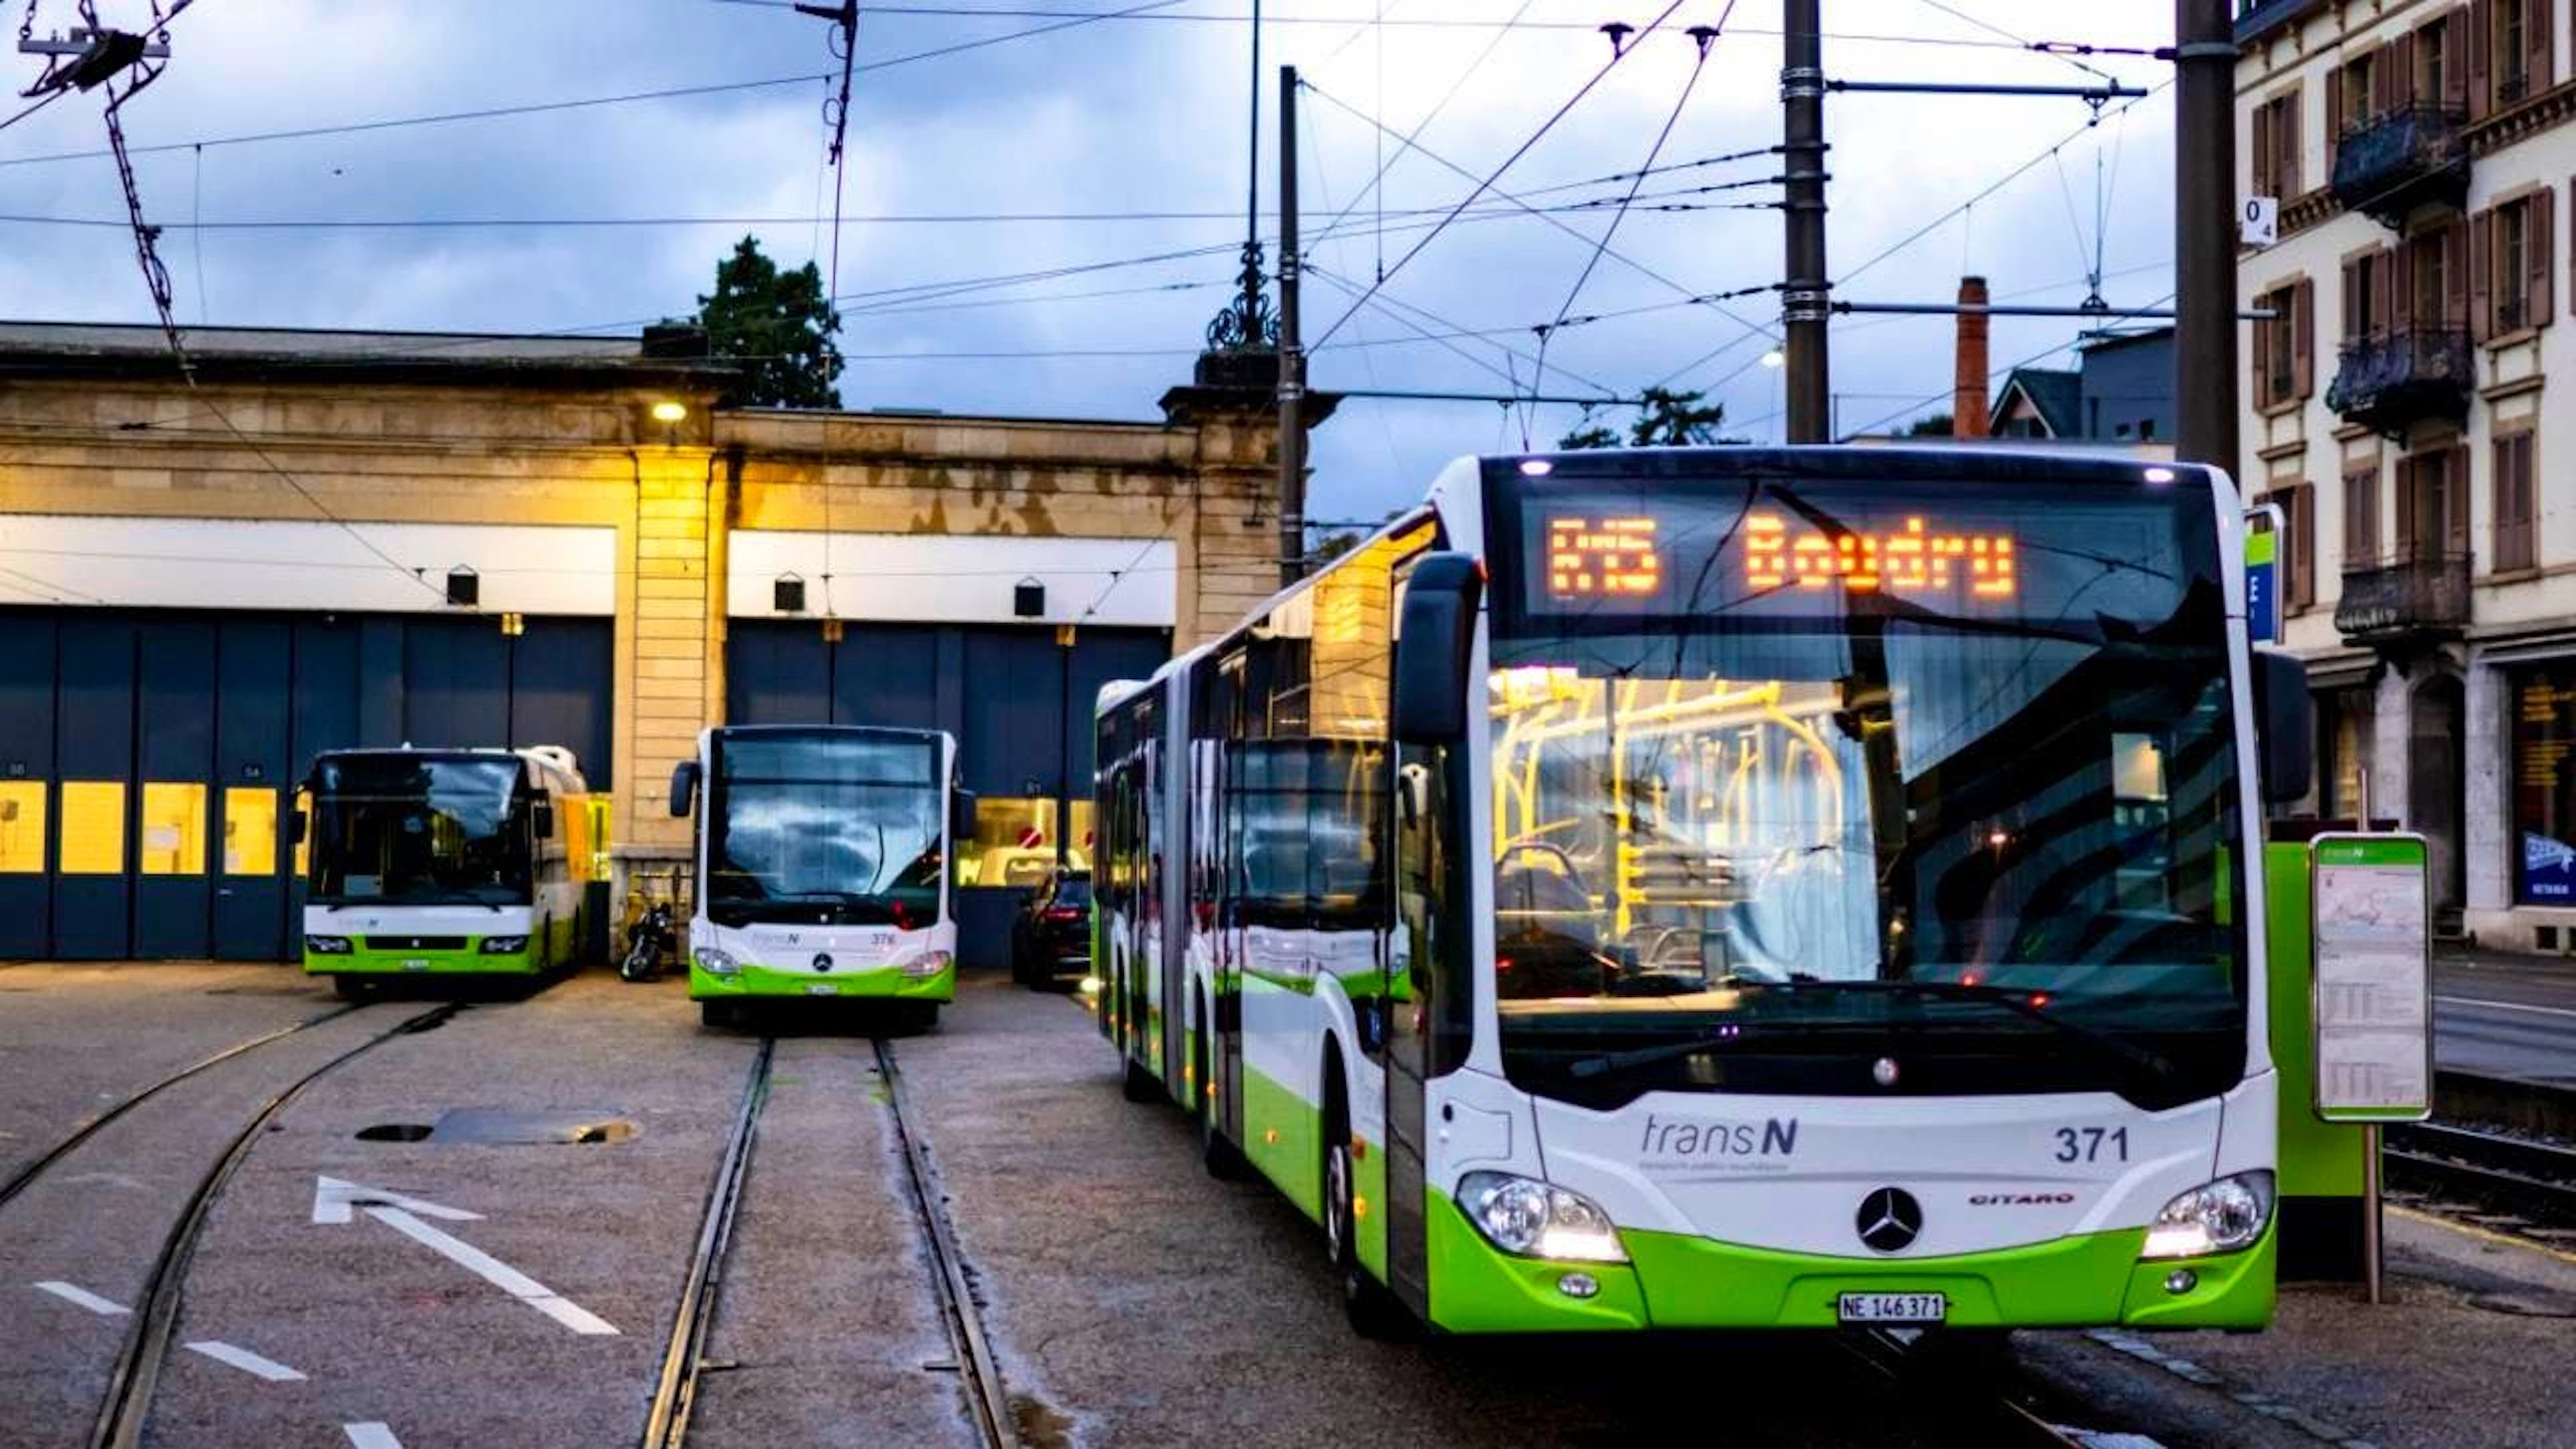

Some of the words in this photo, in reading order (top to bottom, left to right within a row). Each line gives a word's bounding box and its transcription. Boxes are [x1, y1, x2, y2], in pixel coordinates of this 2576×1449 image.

[1747, 515, 2014, 594] Boudry
[1642, 1114, 1798, 1155] transN
[2055, 1126, 2128, 1163] 371
[1968, 1193, 2075, 1205] CITARO
